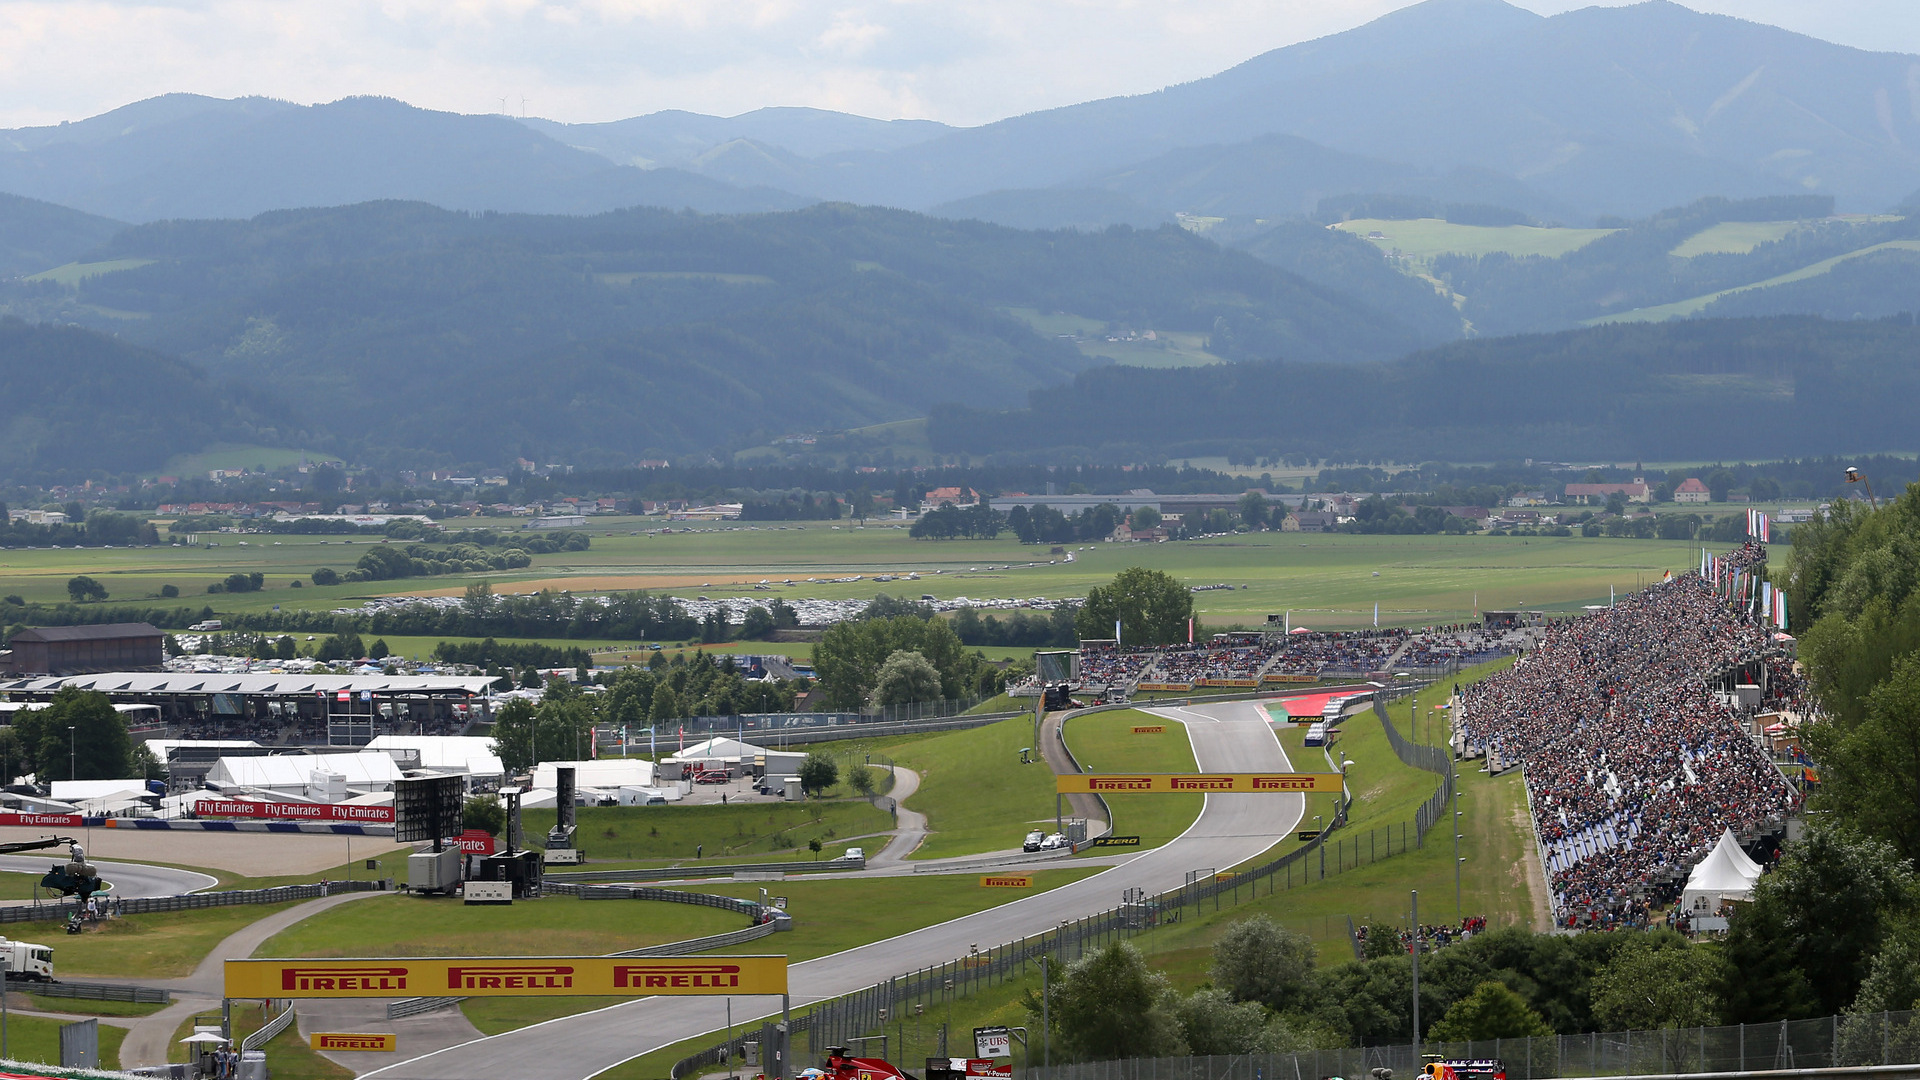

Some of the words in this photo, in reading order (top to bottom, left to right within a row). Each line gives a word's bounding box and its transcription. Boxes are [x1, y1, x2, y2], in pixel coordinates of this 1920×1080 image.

[1089, 778, 1152, 789] PIRELLI
[1171, 777, 1234, 789] PIRELLI
[1252, 777, 1315, 789] PIRELLI
[198, 801, 214, 814] Fly
[215, 802, 254, 814] Emirates
[265, 804, 280, 817] Fly
[281, 804, 321, 816] Emirates
[332, 806, 348, 818] Fly
[349, 806, 389, 818] Emirates
[20, 815, 34, 824] Fly
[35, 815, 71, 824] Emirates
[986, 878, 1026, 886] PIRELLI
[282, 968, 409, 990] PIRELLI
[448, 966, 574, 989] PIRELLI
[613, 965, 740, 988] PIRELLI
[320, 1035, 386, 1049] PIRELLI
[989, 1036, 1009, 1046] UBS
